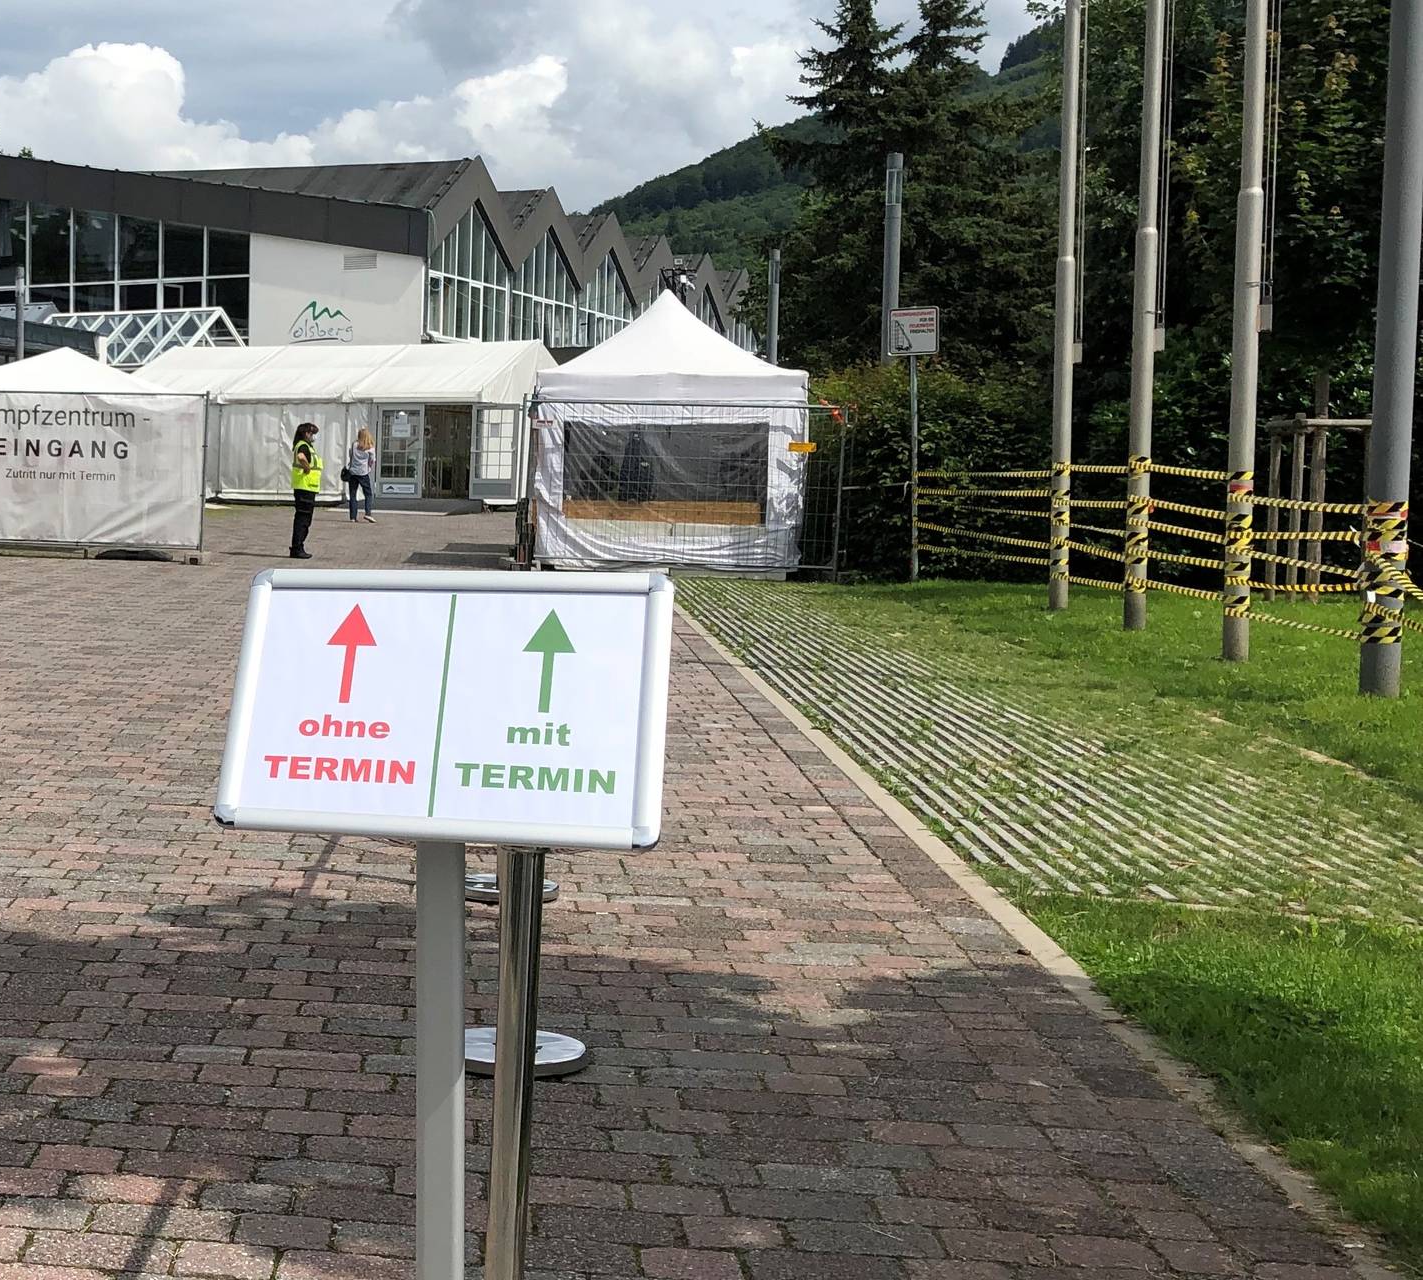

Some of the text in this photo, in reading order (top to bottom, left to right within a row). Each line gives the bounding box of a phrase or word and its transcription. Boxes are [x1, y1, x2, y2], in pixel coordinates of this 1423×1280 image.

[292, 319, 354, 343] olsberg
[5, 468, 116, 481] Zutritt nur mit Termin
[298, 714, 391, 739] ohne
[506, 722, 571, 747] mit
[264, 755, 416, 785] TERMIN
[454, 762, 616, 795] TERMIN
